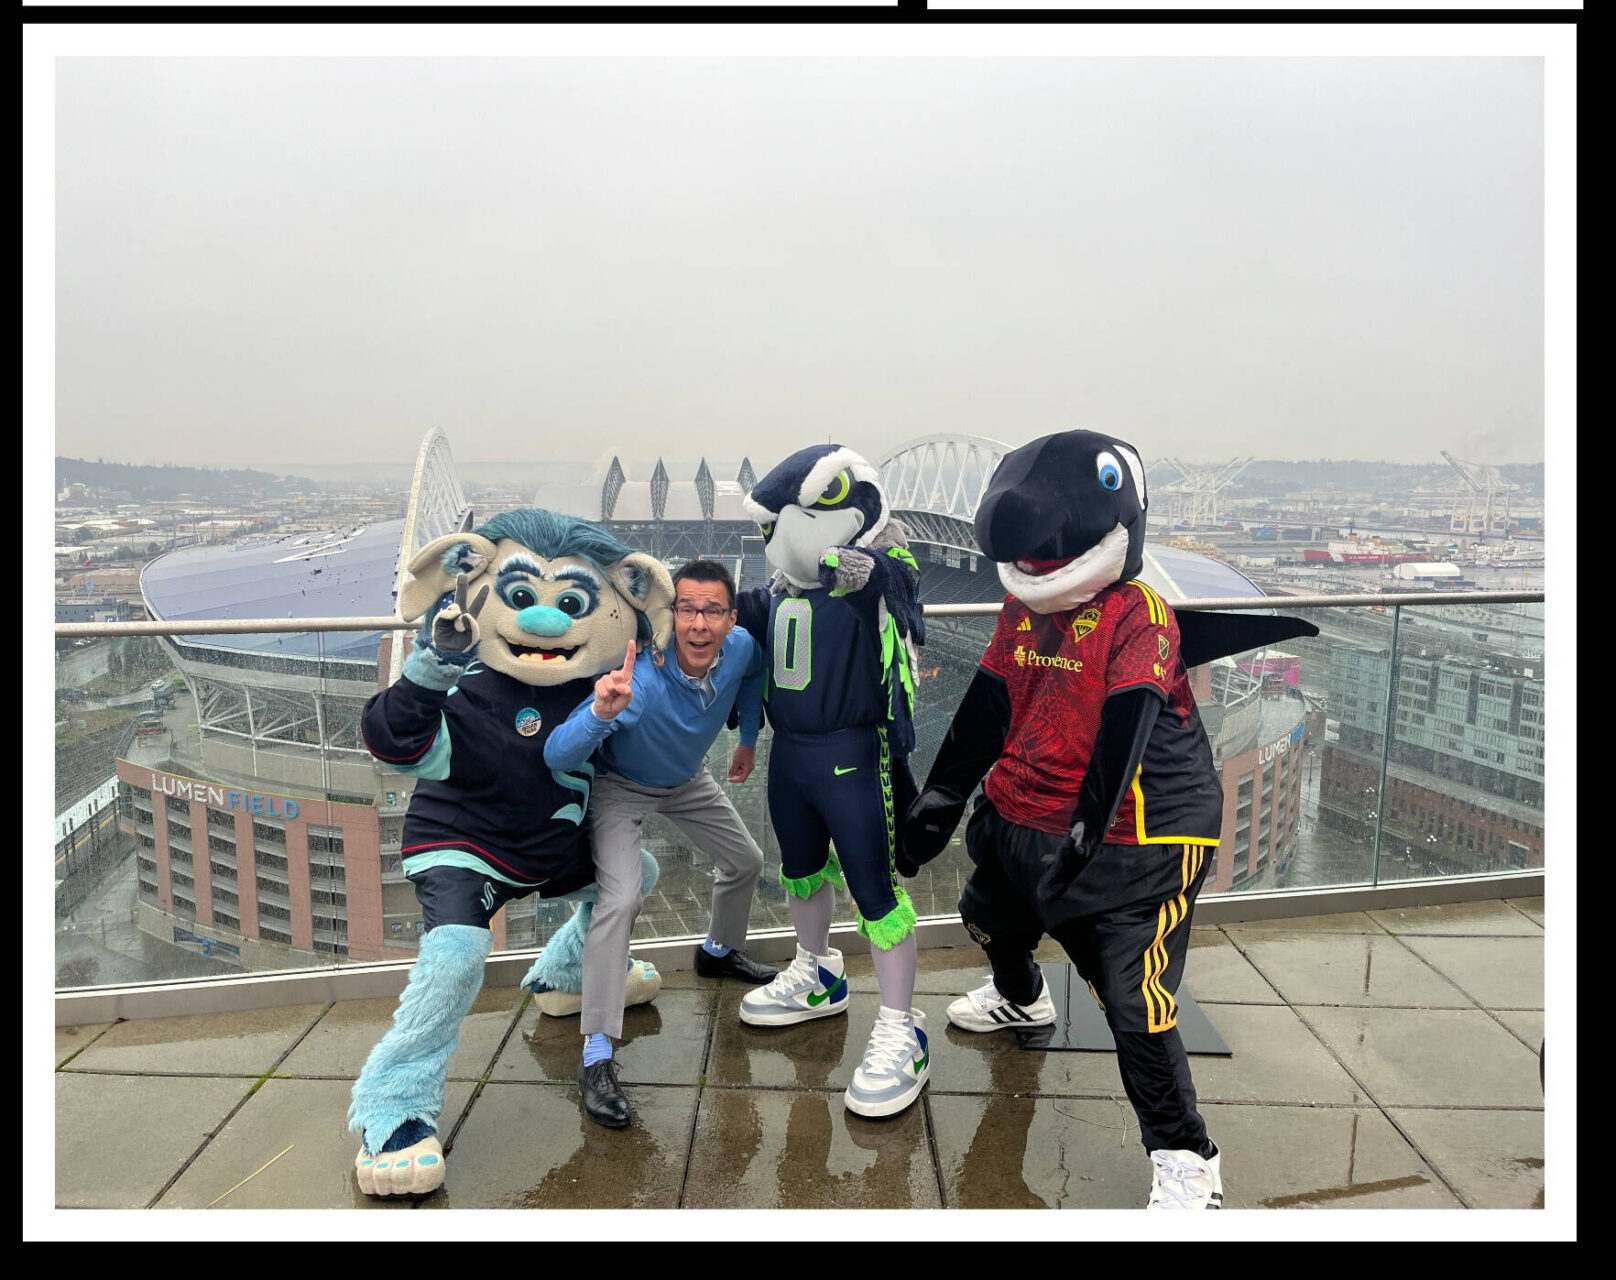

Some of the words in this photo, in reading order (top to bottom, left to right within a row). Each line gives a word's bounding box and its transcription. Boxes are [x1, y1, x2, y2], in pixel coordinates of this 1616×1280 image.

[774, 598, 813, 691] 0
[1258, 733, 1292, 765] LUMEN
[152, 773, 224, 806] LUMEN
[228, 790, 299, 819] FIELD
